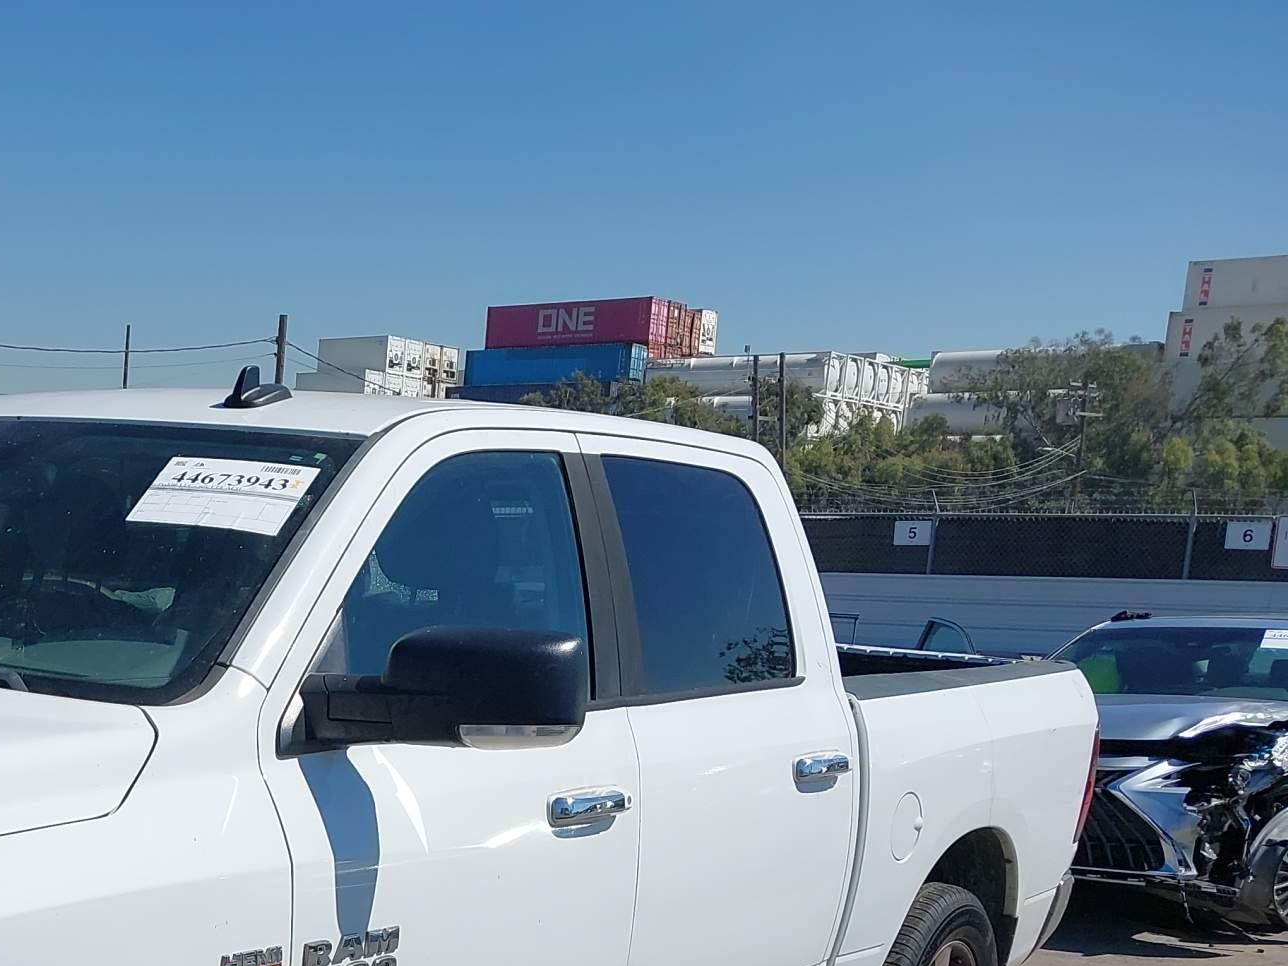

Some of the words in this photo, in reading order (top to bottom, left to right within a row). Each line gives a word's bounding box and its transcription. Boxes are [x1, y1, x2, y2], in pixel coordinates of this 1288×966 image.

[537, 306, 596, 333] ONE
[171, 470, 290, 491] 44673943
[908, 526, 918, 539] 5
[1242, 528, 1254, 543] 6
